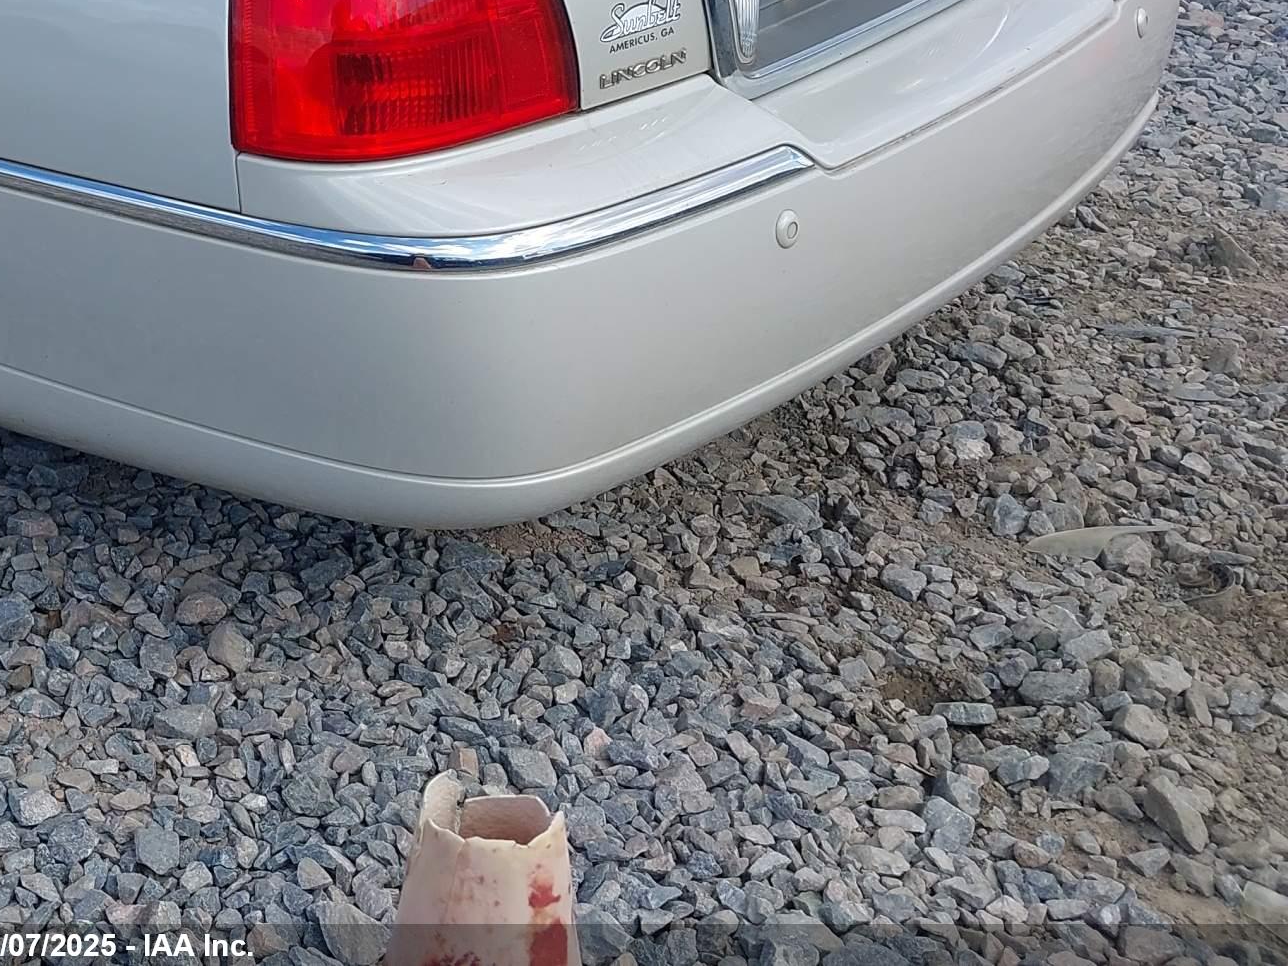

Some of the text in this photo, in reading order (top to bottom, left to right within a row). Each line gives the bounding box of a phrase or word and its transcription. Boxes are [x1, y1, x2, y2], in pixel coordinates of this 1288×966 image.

[609, 26, 675, 54] AMERICUS, GA
[599, 47, 687, 89] LINCOLN
